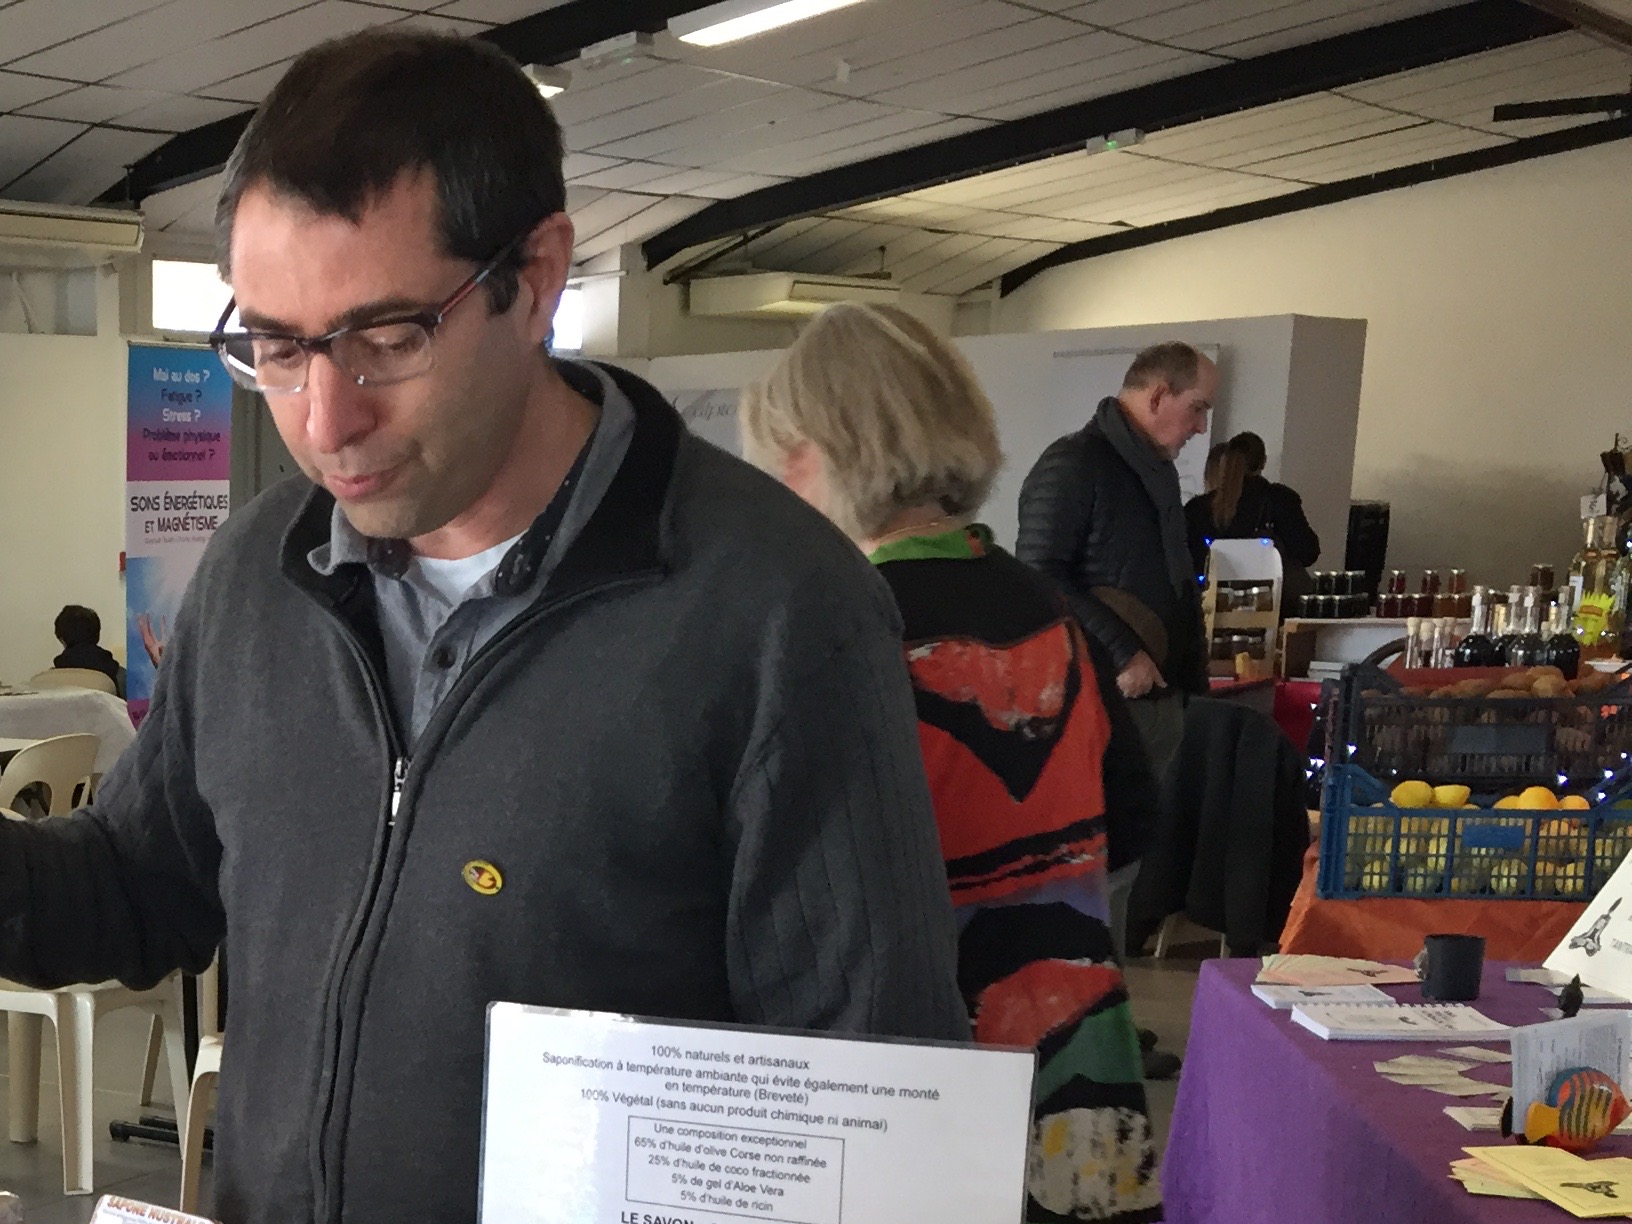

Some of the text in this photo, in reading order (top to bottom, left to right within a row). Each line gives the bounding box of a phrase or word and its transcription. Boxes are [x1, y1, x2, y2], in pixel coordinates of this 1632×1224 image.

[161, 388, 193, 406] Fatigue
[162, 407, 192, 422] Stress
[163, 489, 228, 511] ÉNERGÉTIQUES
[144, 511, 218, 533] ET MAGNÉTISME
[651, 1045, 810, 1070] 100% naturels et artisanaux
[542, 1051, 940, 1101] Saponification à température ambiante qui évite également une monté
[665, 1081, 809, 1106] en température (Breveté)
[580, 1088, 889, 1134] 100% Végétal (sans aucun produit chimique ni animal)
[653, 1123, 807, 1150] Une composition exceptionnel
[634, 1136, 827, 1169] 65% d'huile d'olive Corse non raffinée
[648, 1154, 811, 1184] 25% d'huile de coco fractionnée
[671, 1173, 688, 1185] 5%
[690, 1175, 704, 1187] de
[706, 1176, 722, 1191] gel
[759, 1183, 785, 1197] Vera
[680, 1190, 697, 1202] 5%
[699, 1192, 733, 1208] d'huile
[735, 1197, 749, 1210] de
